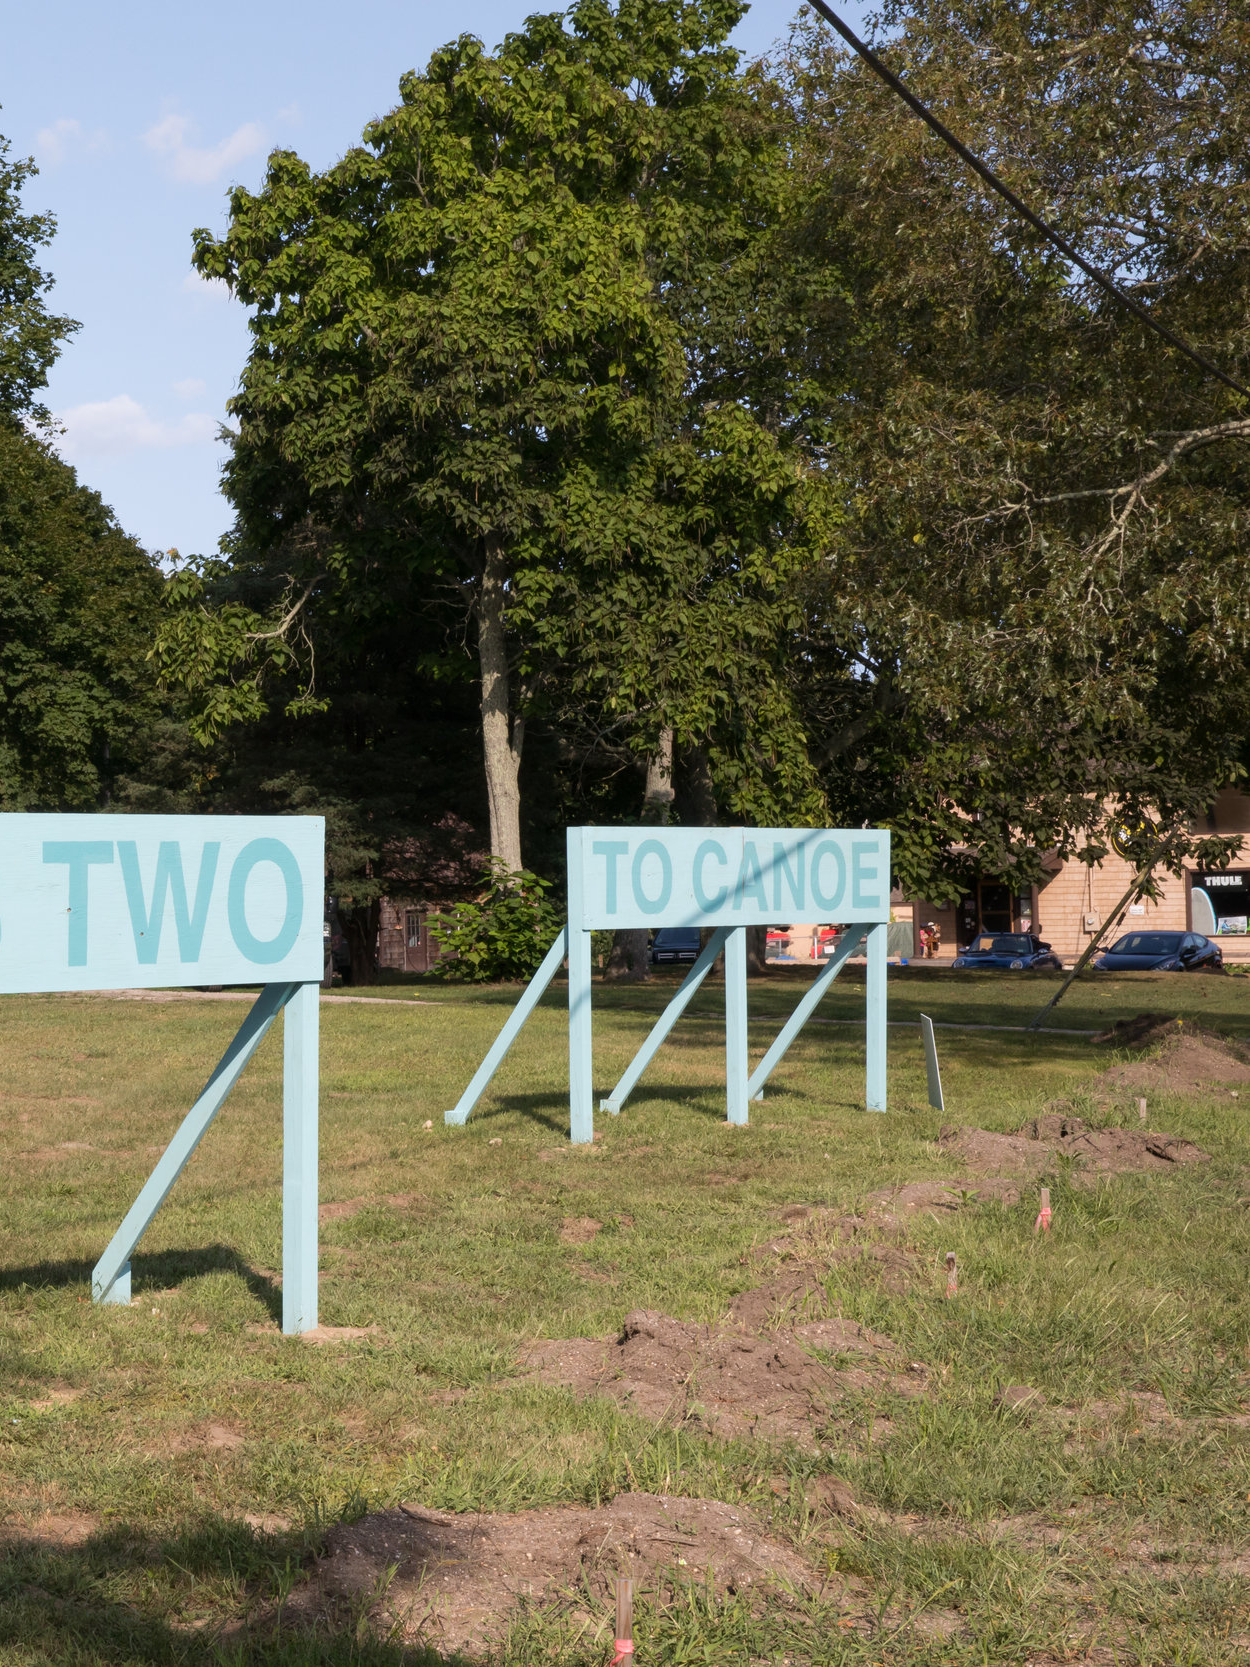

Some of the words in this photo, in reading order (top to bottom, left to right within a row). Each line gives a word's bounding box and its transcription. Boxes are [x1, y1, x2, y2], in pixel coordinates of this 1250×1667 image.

[42, 837, 304, 967] TWO
[592, 839, 673, 915] TO
[692, 839, 881, 914] CANOE
[1204, 875, 1243, 886] THULE
